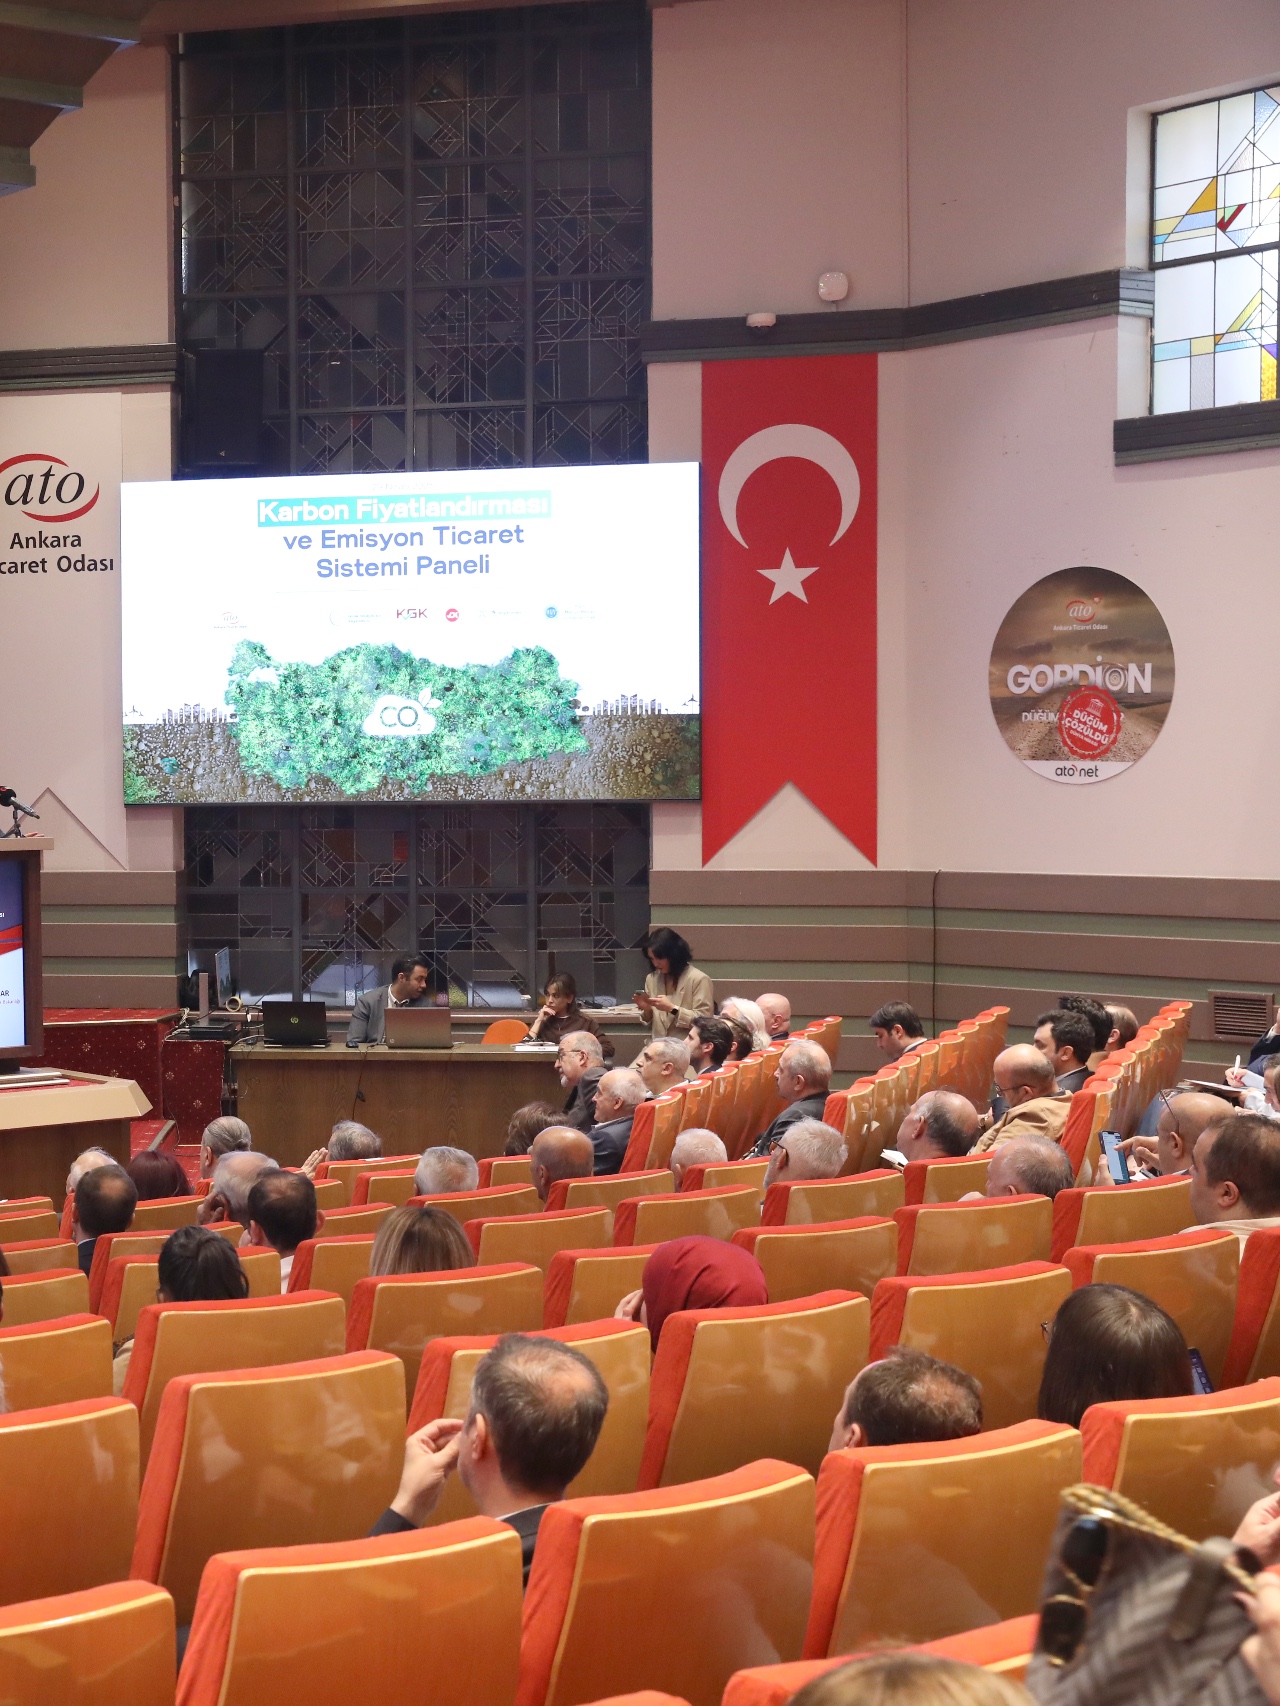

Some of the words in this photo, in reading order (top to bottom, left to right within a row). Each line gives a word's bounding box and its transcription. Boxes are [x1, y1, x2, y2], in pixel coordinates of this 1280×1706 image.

[4, 464, 85, 506] ato
[258, 500, 350, 523] Karbon
[356, 495, 549, 523] Fiyatlandırması
[9, 530, 82, 550] Ankara
[282, 534, 313, 550] ve
[321, 528, 424, 552] Emisyon
[432, 524, 525, 546] Ticaret
[56, 553, 114, 573] Odası
[316, 555, 408, 579] Sistemi
[416, 554, 491, 576] Paneli
[396, 608, 428, 620] KGK
[1069, 604, 1092, 617] ato
[1065, 717, 1109, 745] ÇÖZÜLDÜ
[1072, 709, 1108, 733] DÜĞÜM
